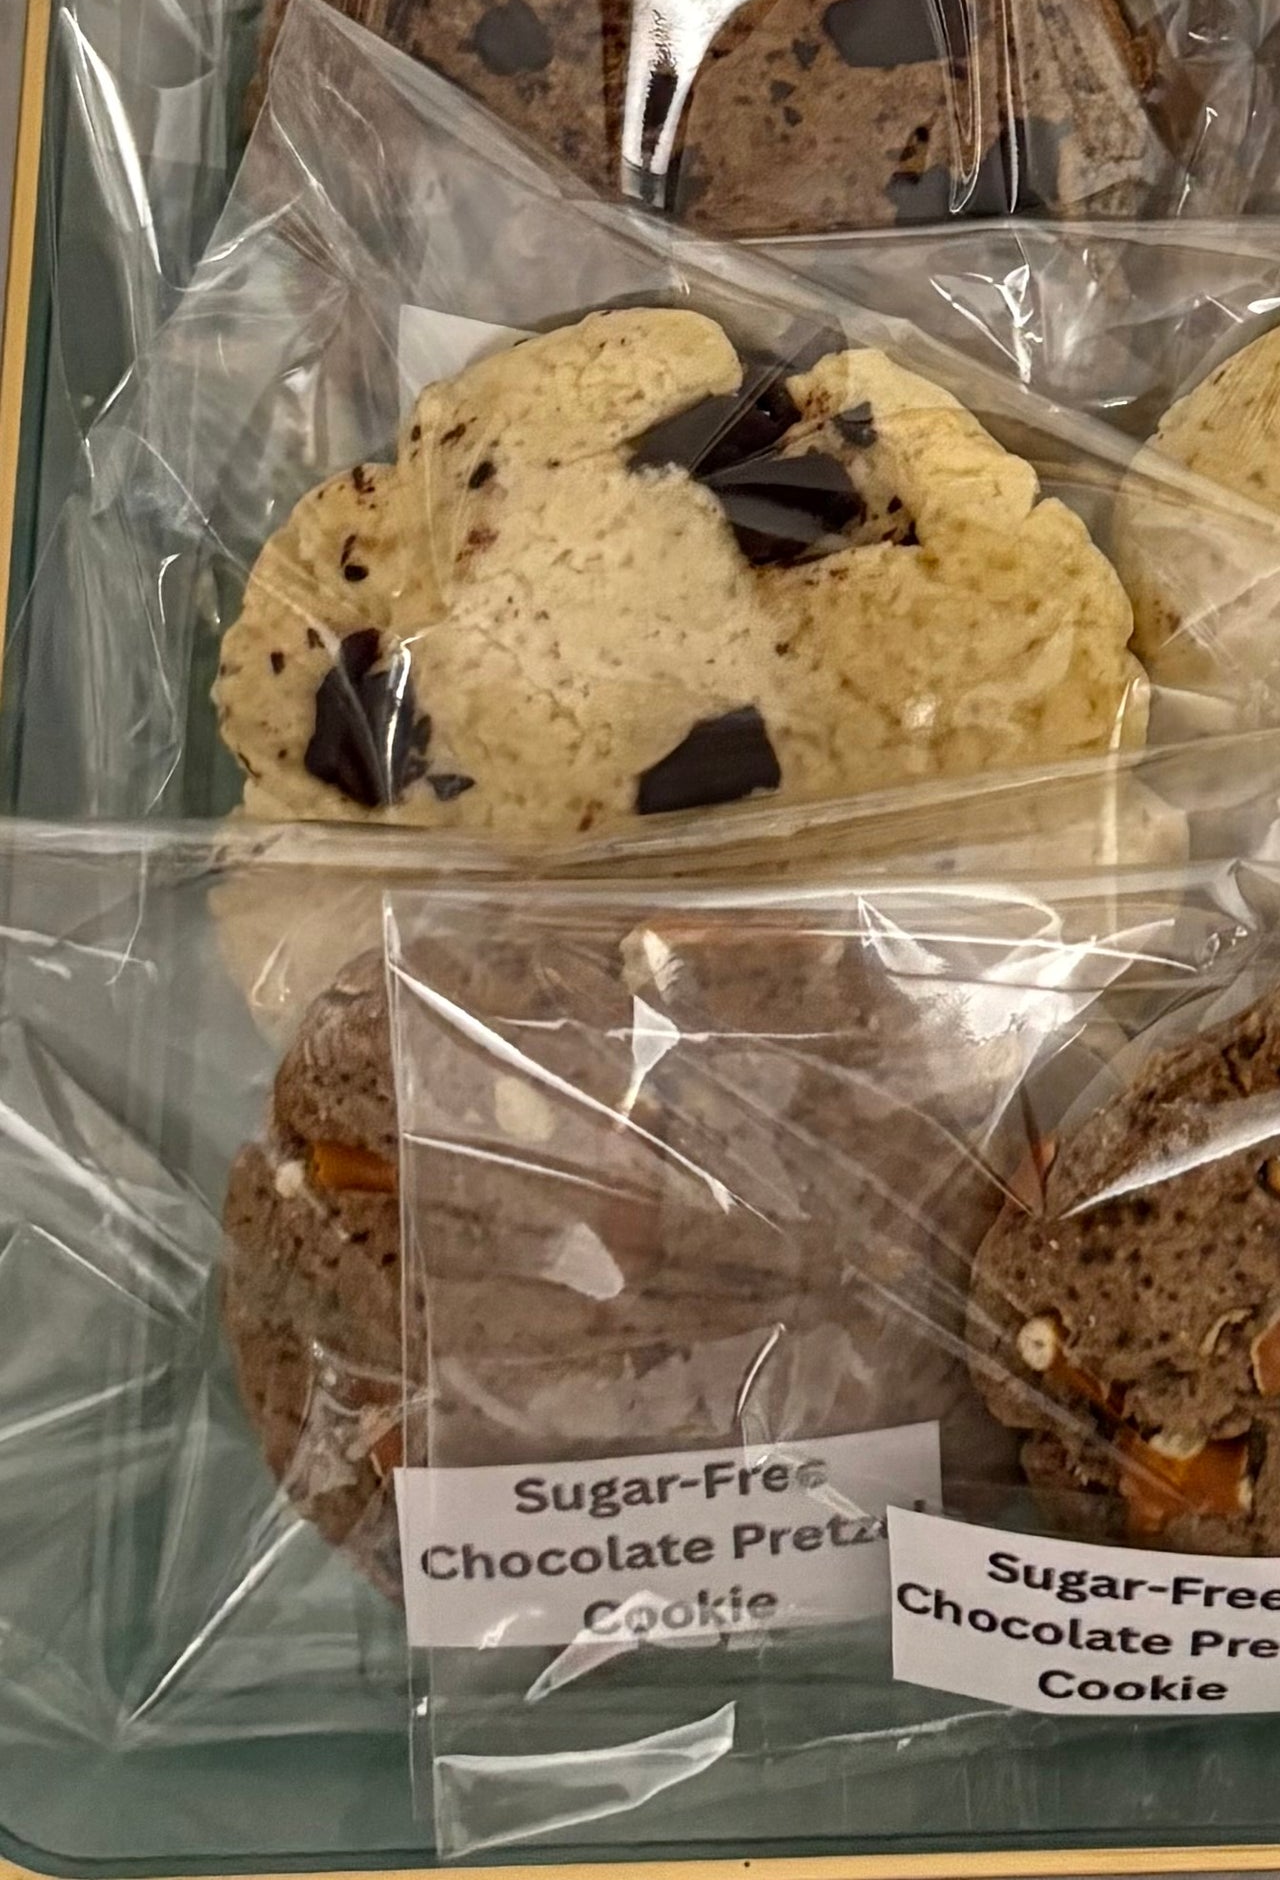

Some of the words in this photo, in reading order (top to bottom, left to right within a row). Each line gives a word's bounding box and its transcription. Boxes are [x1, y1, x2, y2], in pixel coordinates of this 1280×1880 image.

[514, 1457, 829, 1518] Sugar-Free
[422, 1533, 714, 1581] Chocolate
[733, 1502, 923, 1560] Pretz
[583, 1583, 779, 1635] Cookie
[896, 1581, 1173, 1656] Chocolate
[1038, 1668, 1229, 1702] Cookie
